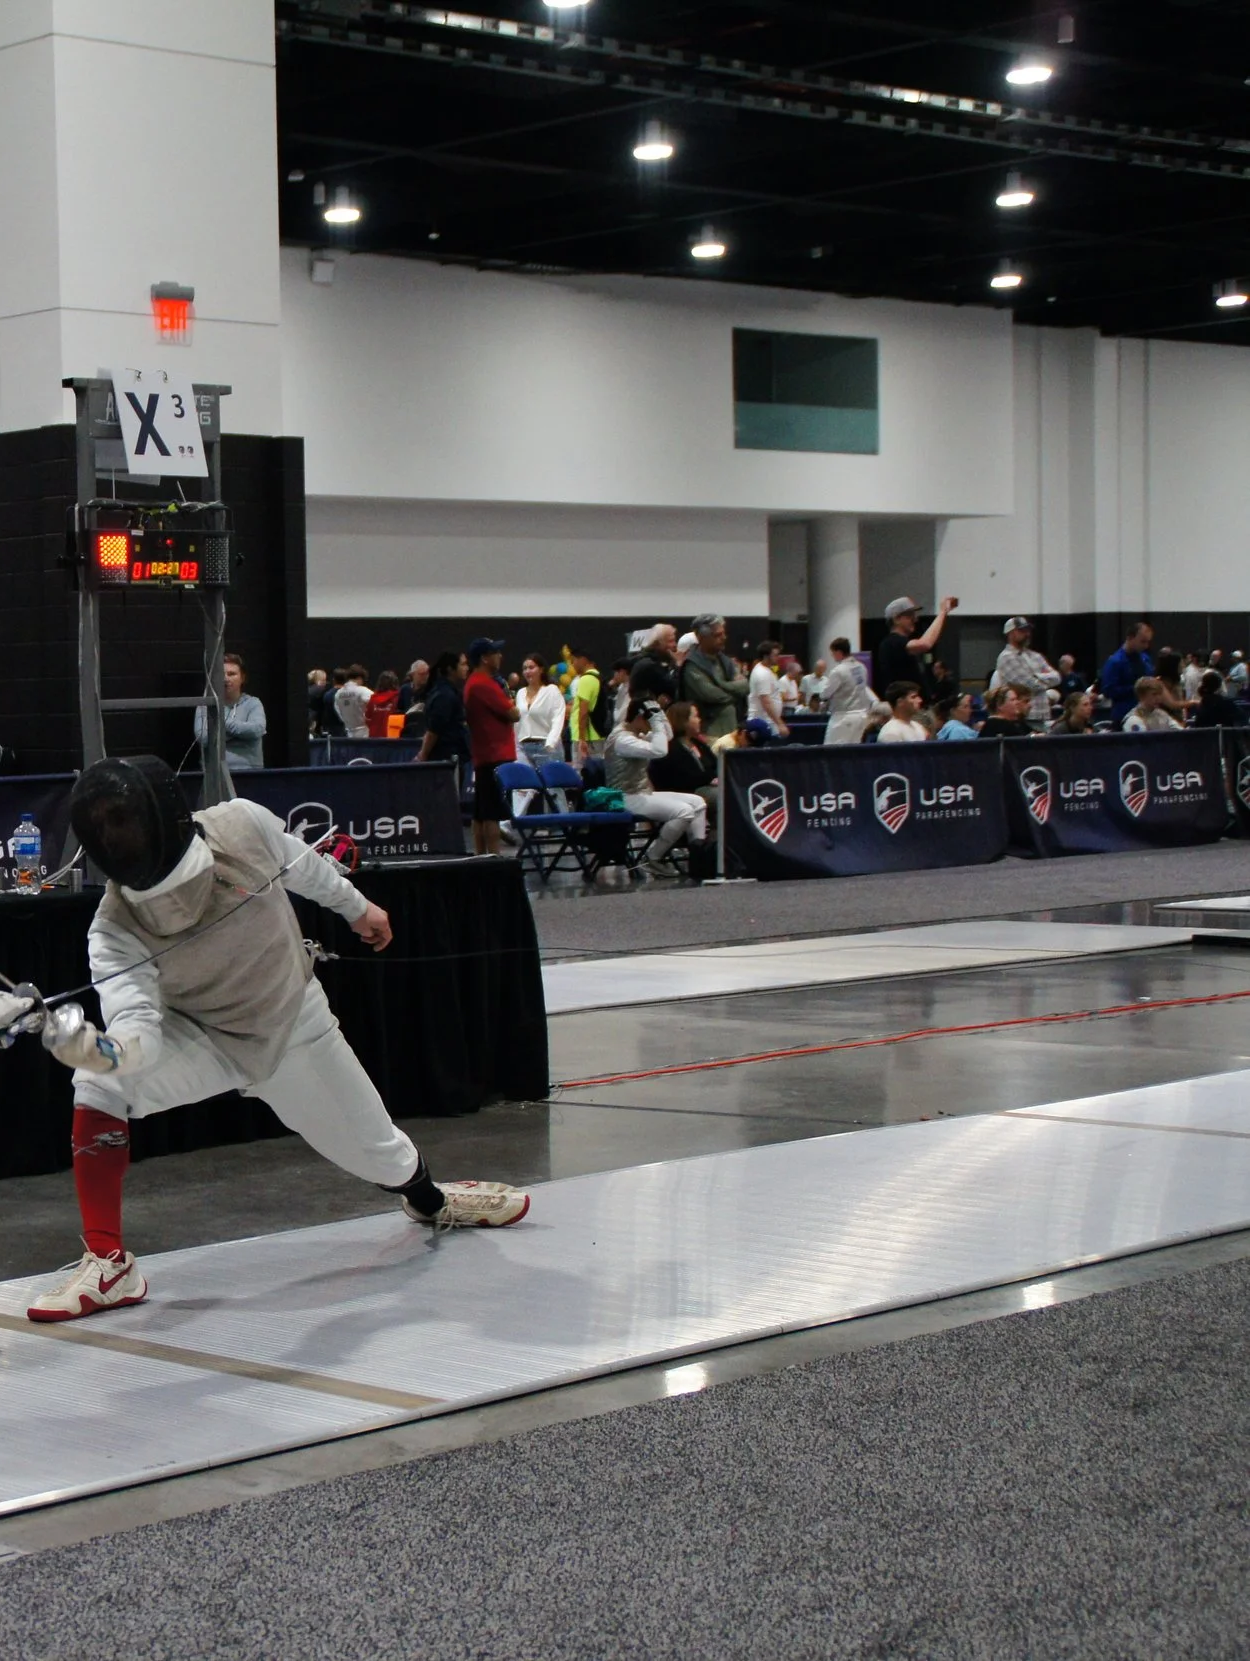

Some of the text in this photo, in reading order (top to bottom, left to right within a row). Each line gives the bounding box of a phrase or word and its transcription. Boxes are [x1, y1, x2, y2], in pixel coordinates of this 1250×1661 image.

[124, 391, 172, 457] X
[171, 394, 185, 418] 3
[180, 562, 199, 579] 03
[1059, 778, 1105, 799] USA
[1156, 771, 1203, 792] USA
[799, 792, 856, 814] USA
[919, 784, 974, 806] USA
[349, 815, 420, 840] USA
